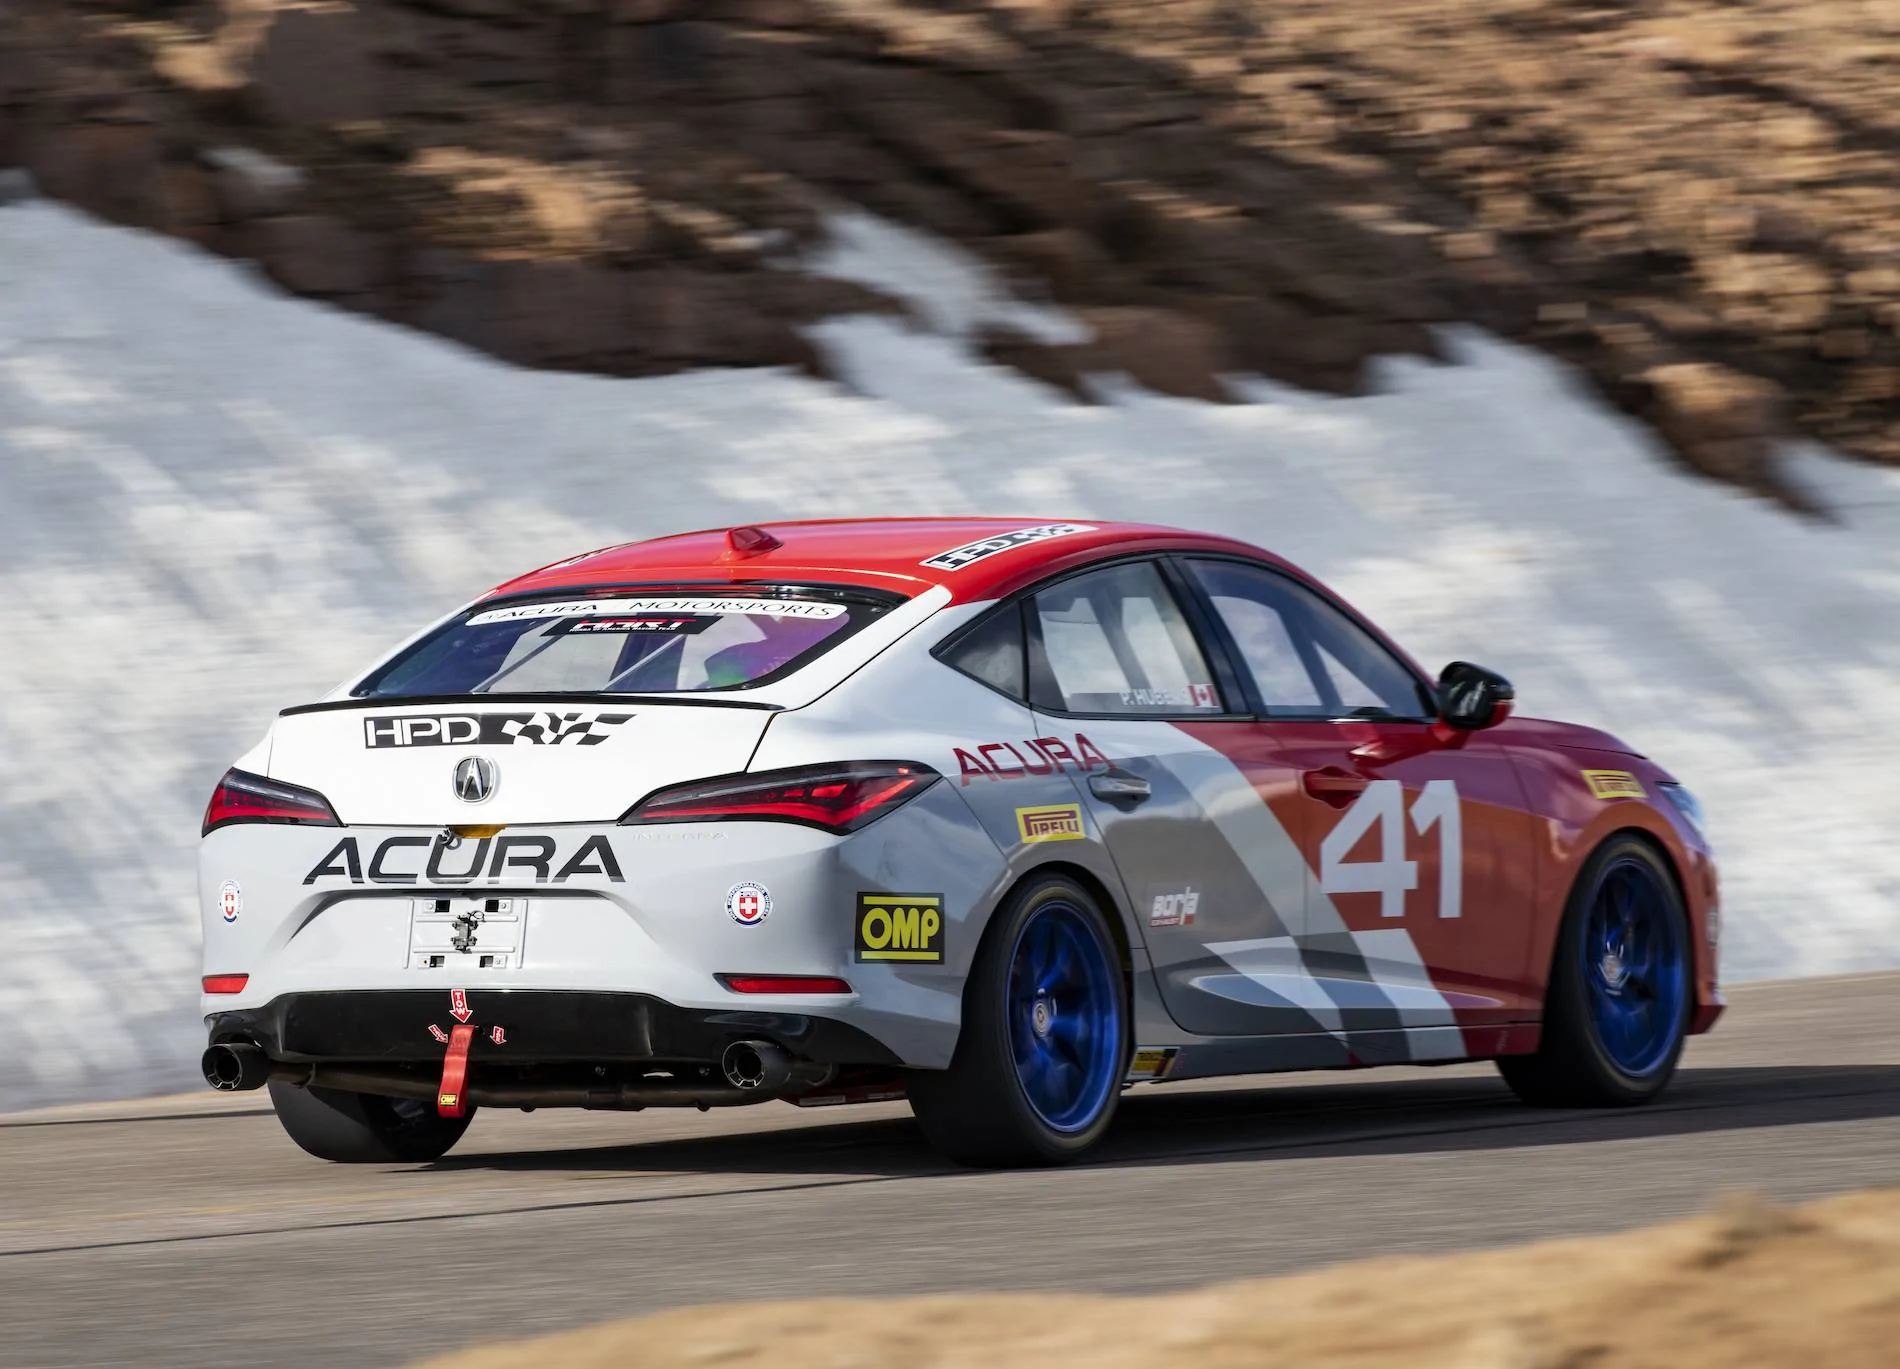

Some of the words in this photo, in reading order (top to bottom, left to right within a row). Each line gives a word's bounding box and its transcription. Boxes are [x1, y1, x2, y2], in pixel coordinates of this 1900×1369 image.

[928, 538, 1013, 569] HPD
[499, 604, 598, 618] ACURA
[629, 601, 836, 617] MOTORSPORTS
[365, 716, 481, 747] HPD
[953, 733, 1117, 787] ACURA
[1022, 810, 1080, 837] PIRELLI
[302, 834, 627, 886] ACURA
[1320, 779, 1463, 919] 41
[861, 907, 940, 950] OMP
[454, 991, 466, 1016] TOW
